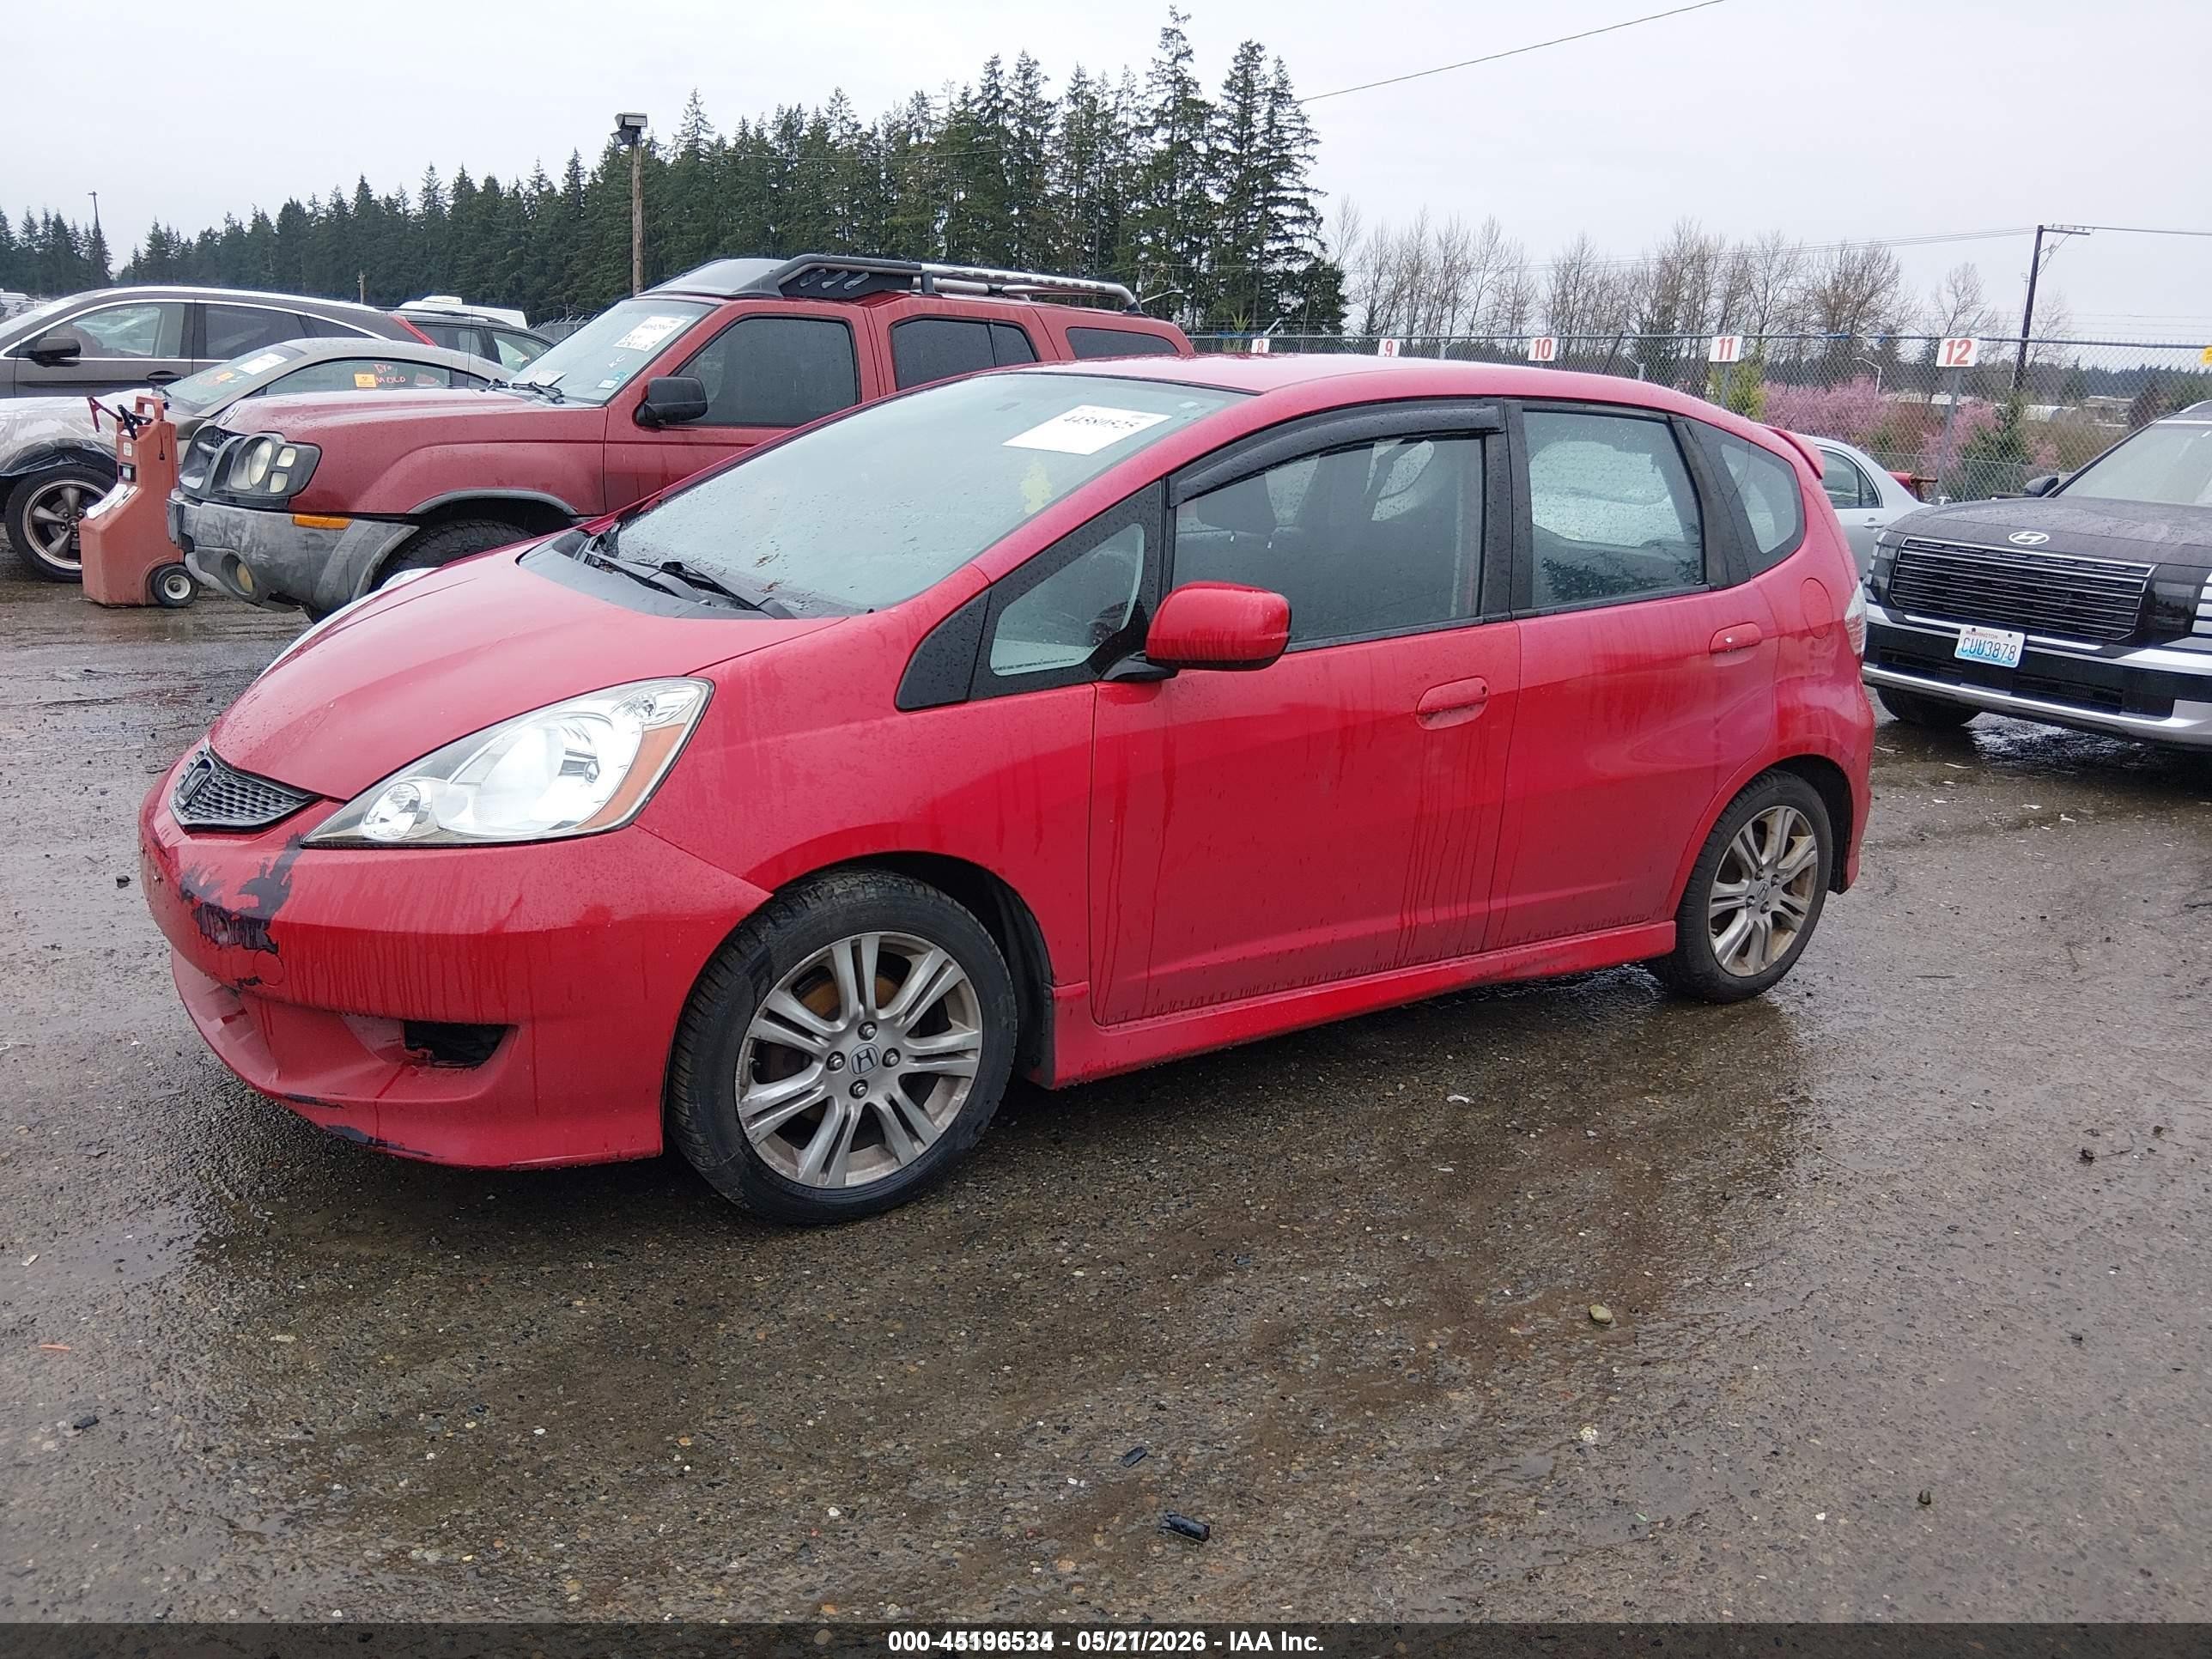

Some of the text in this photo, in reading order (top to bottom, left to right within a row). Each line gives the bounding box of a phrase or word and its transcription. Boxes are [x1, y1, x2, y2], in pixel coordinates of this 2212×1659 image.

[1384, 340, 1393, 356] 9
[1534, 338, 1552, 359] 10
[1718, 337, 1734, 360] 11
[1946, 339, 1972, 364] 12
